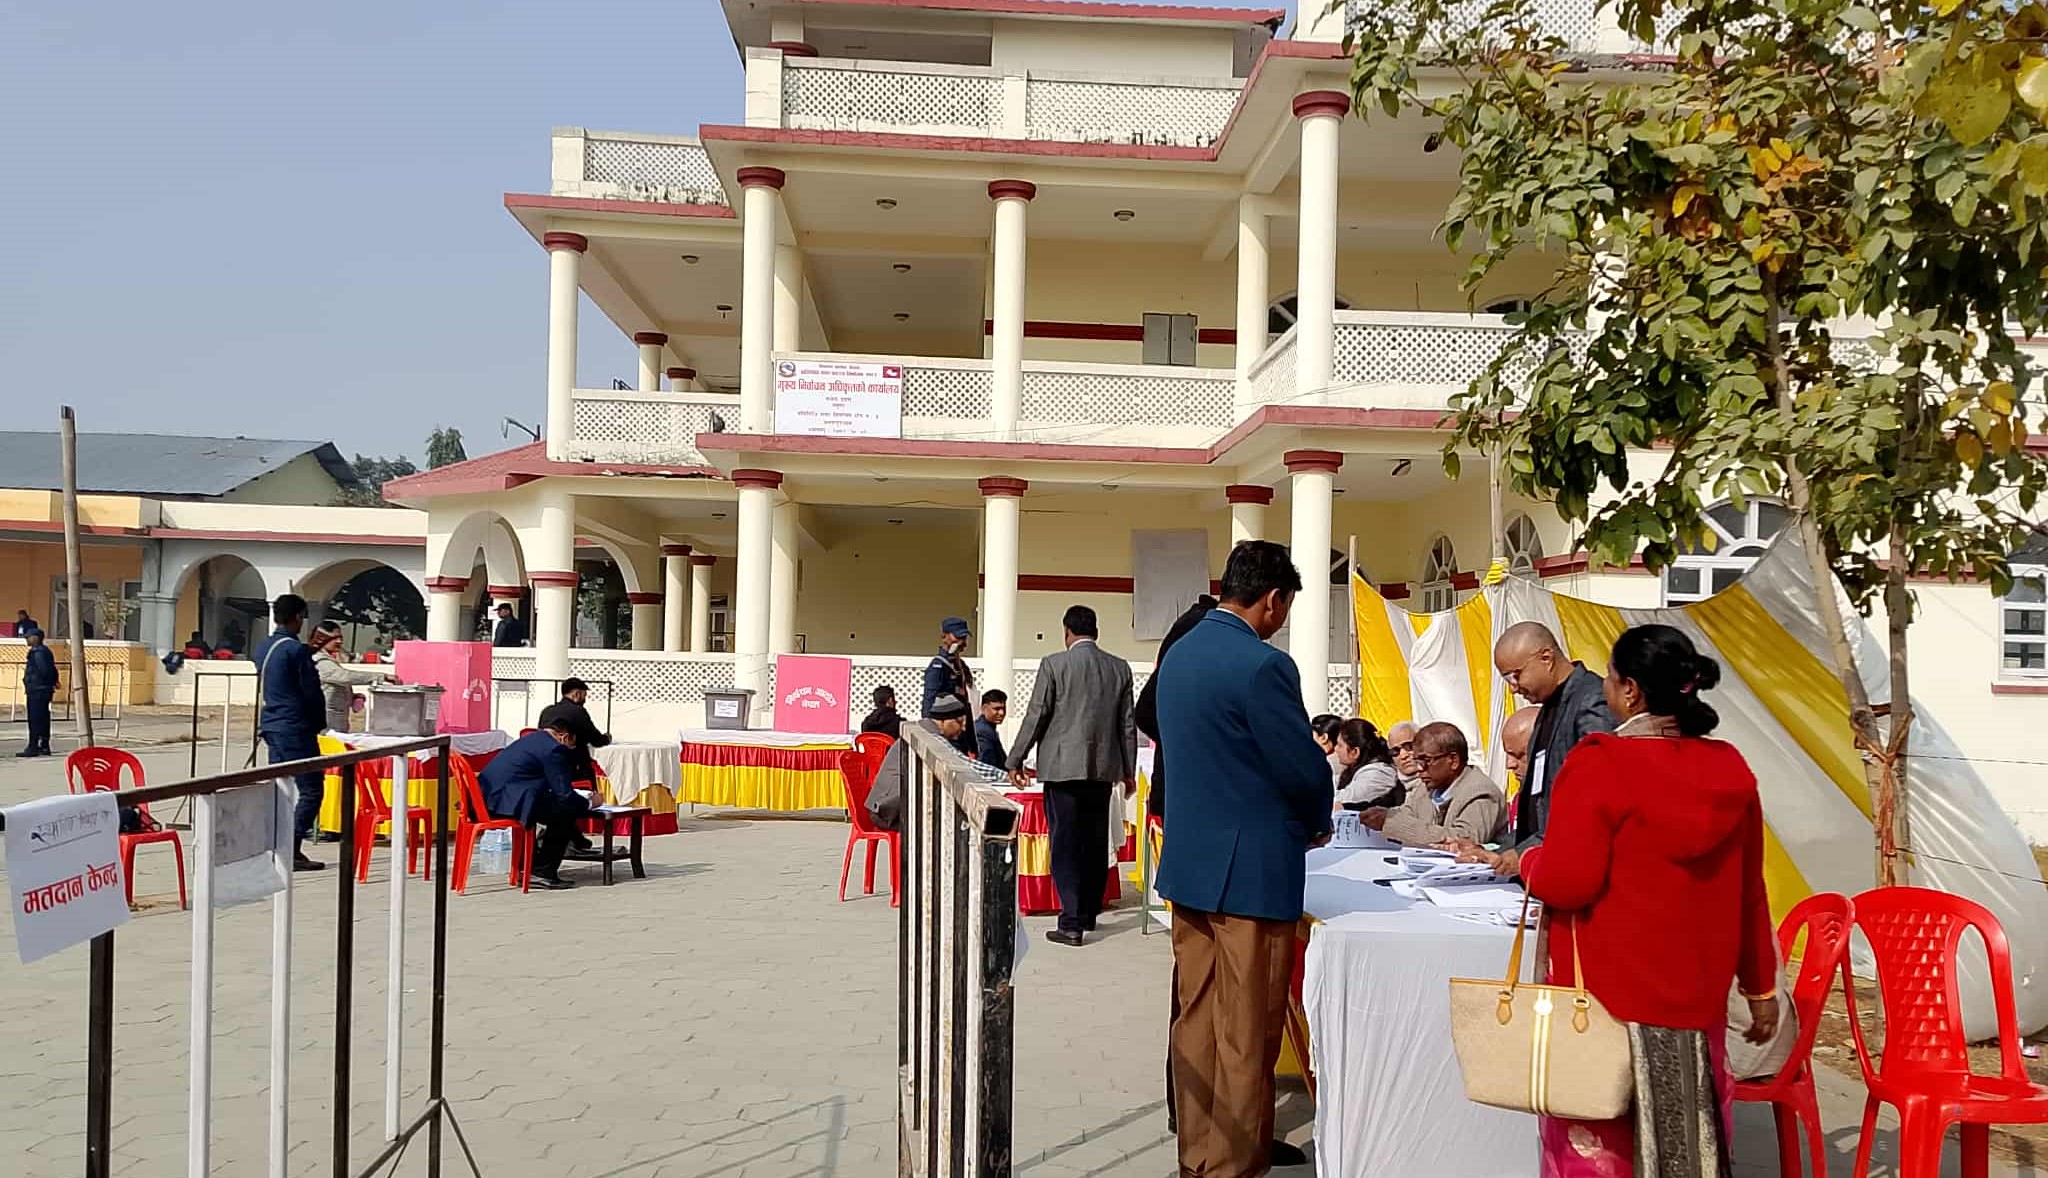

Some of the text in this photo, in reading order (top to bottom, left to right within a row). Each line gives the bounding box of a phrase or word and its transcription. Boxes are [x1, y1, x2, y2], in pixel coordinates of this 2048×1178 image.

[798, 378, 825, 391] निर्वाचन
[828, 379, 865, 395] अधिकृतको
[867, 381, 899, 395] कार्यालय
[23, 862, 118, 914] मतदान केन्द्र
